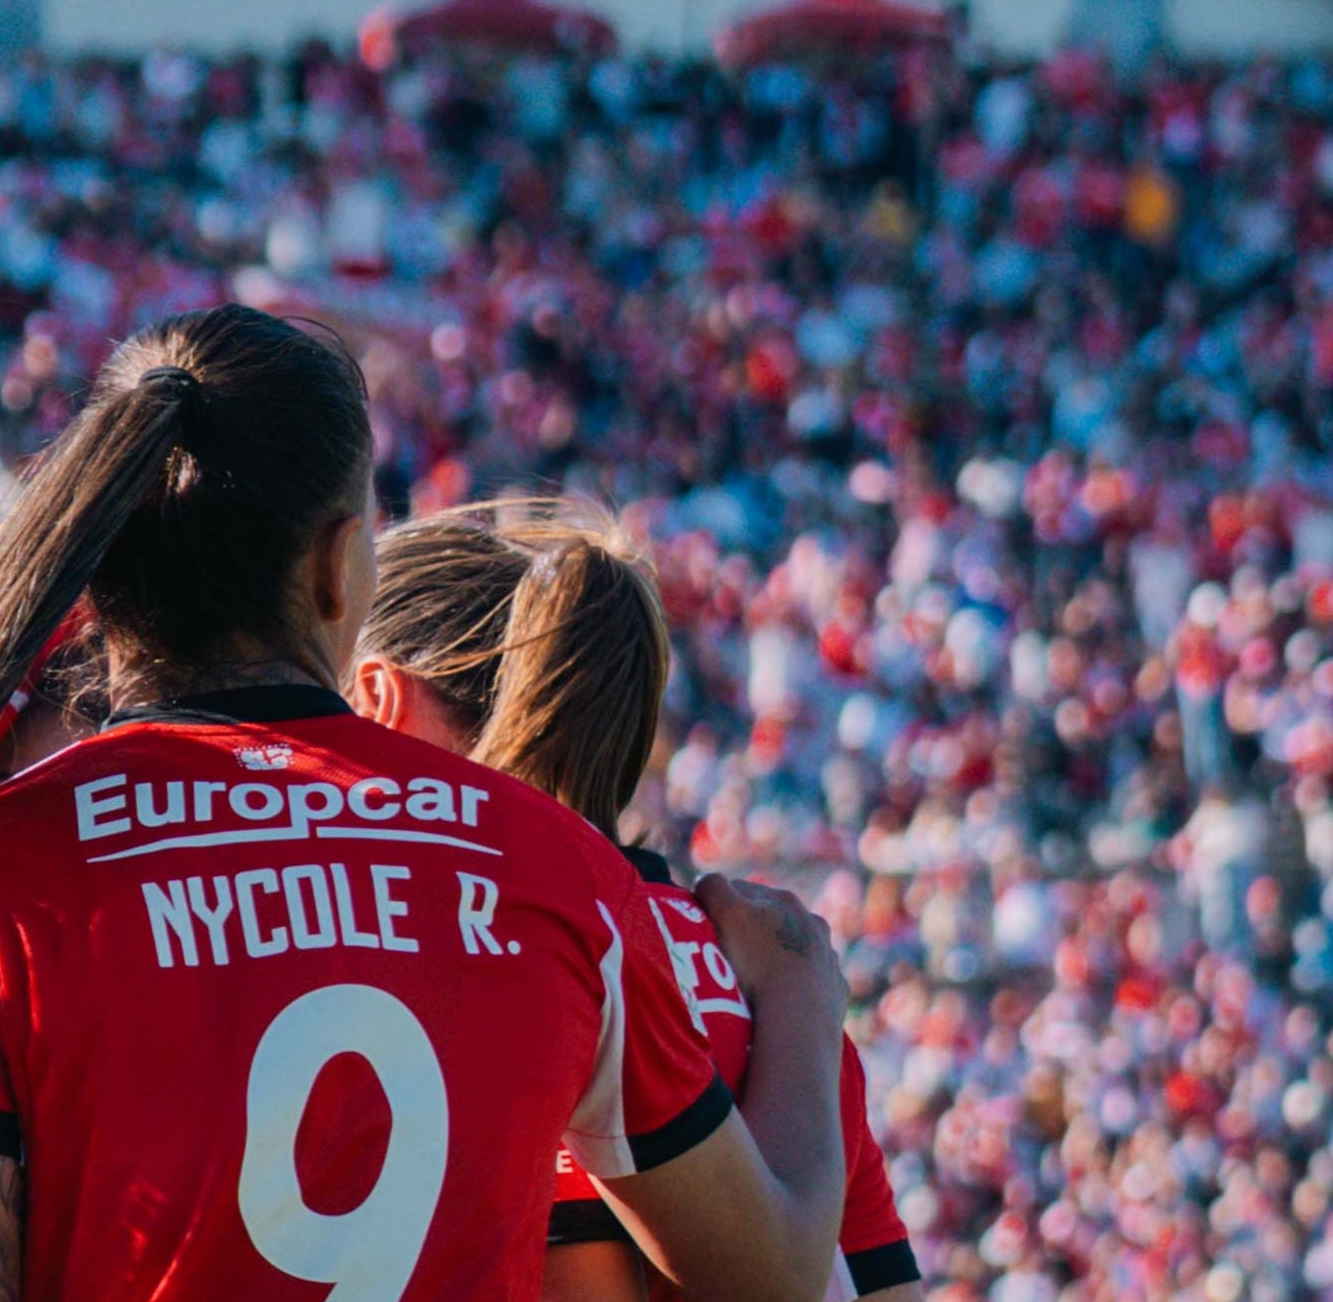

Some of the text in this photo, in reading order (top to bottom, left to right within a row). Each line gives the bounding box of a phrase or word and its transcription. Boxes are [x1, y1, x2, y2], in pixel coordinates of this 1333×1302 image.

[74, 774, 489, 843] Europcar
[142, 863, 522, 968] NYCOLE R.
